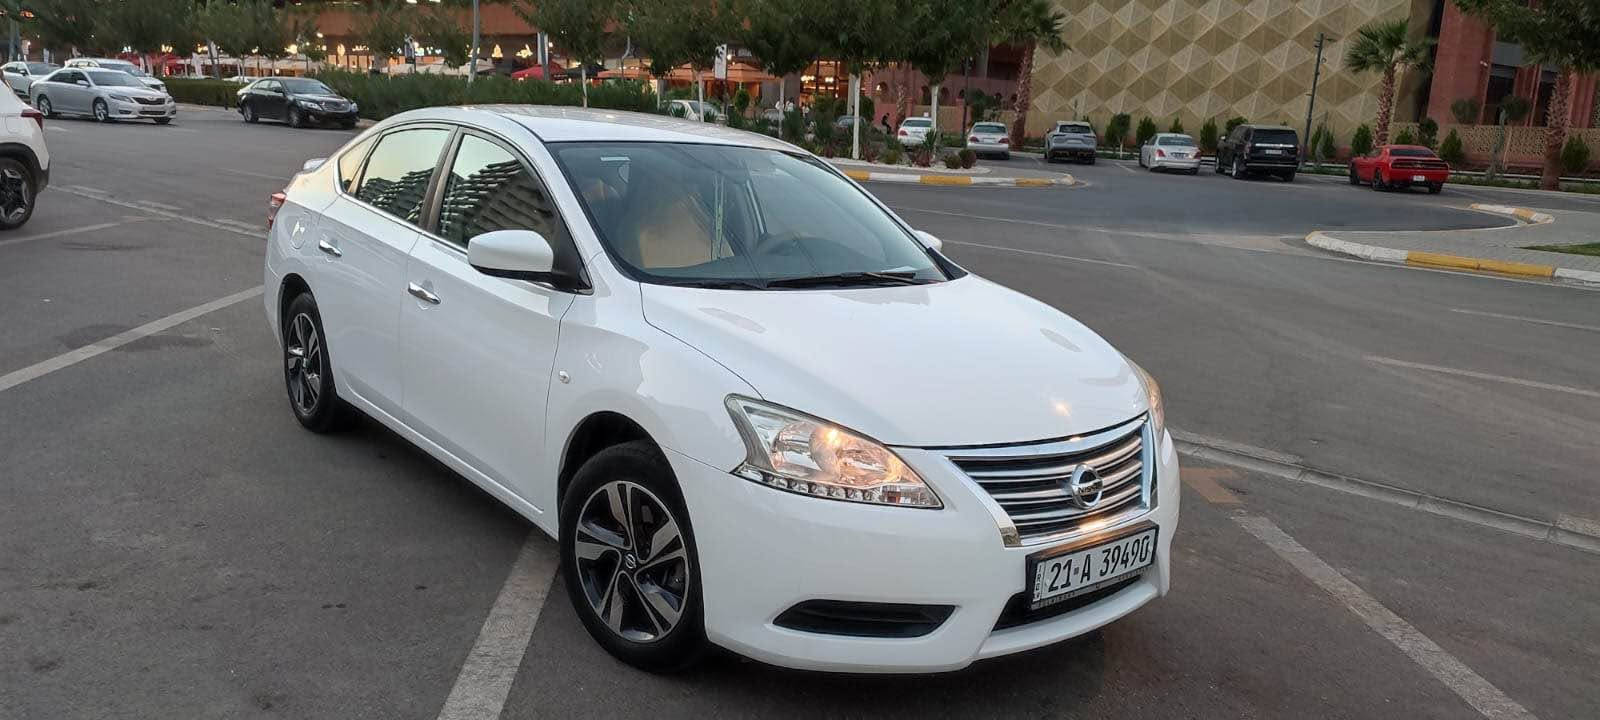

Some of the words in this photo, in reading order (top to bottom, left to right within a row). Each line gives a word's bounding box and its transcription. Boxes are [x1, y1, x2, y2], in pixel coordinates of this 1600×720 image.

[1048, 559, 1072, 592] 21
[1080, 554, 1091, 584] A
[1099, 535, 1149, 577] 39490
